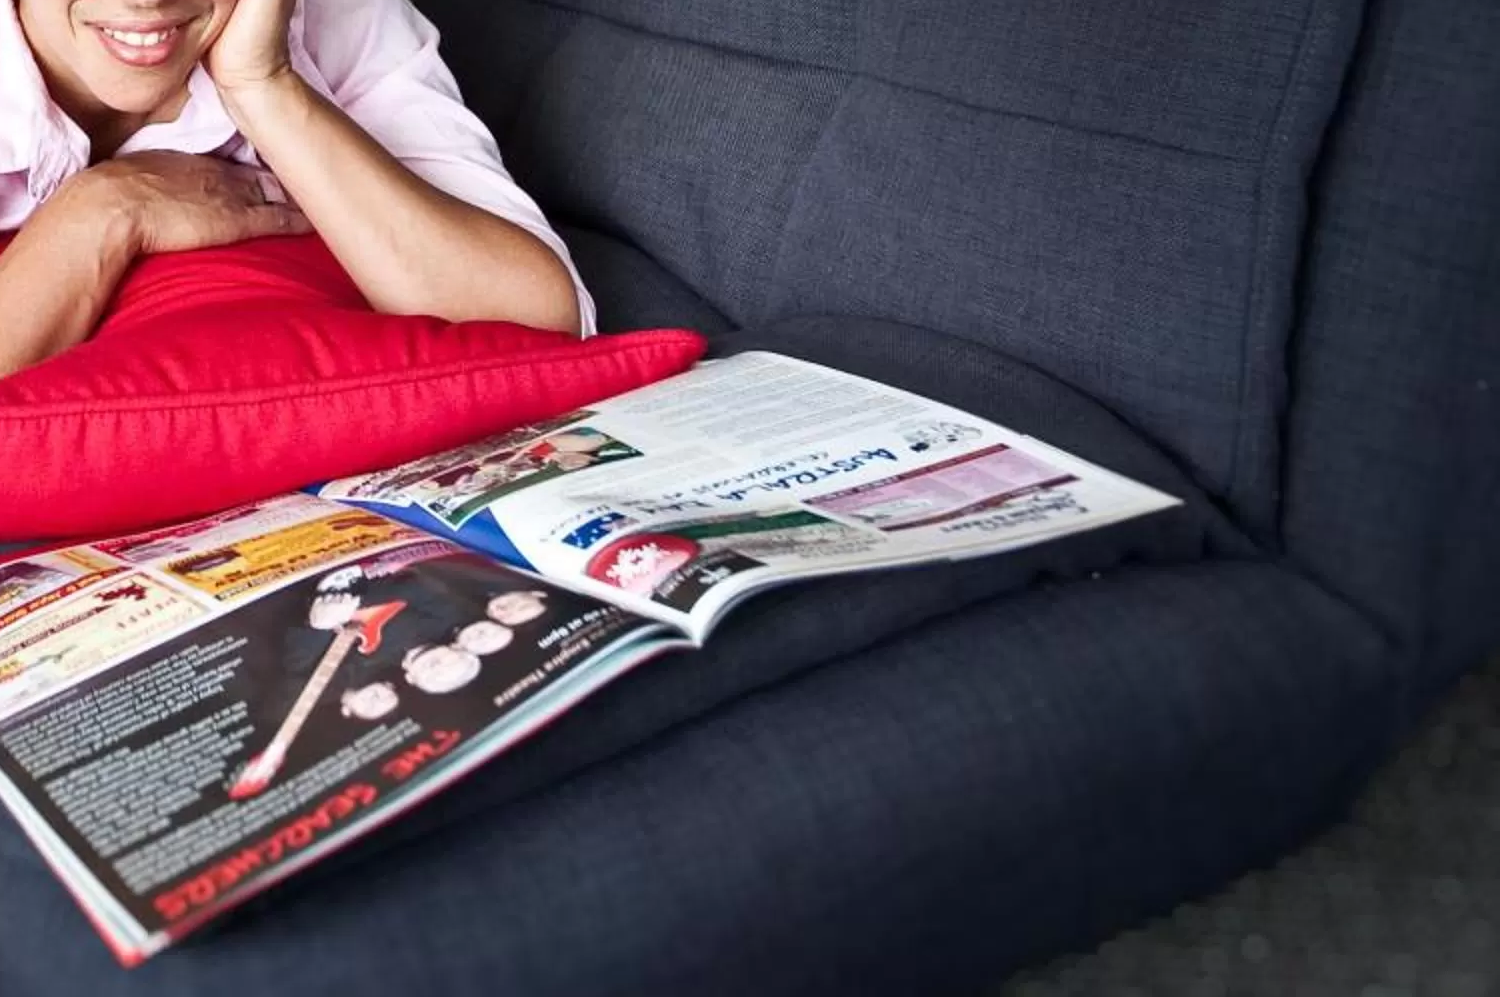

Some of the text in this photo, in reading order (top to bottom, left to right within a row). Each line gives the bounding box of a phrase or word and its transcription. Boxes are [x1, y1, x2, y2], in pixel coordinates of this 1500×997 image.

[717, 446, 898, 504] AUSTRALIA
[379, 729, 461, 782] THE
[150, 780, 379, 922] SEARCHERS
